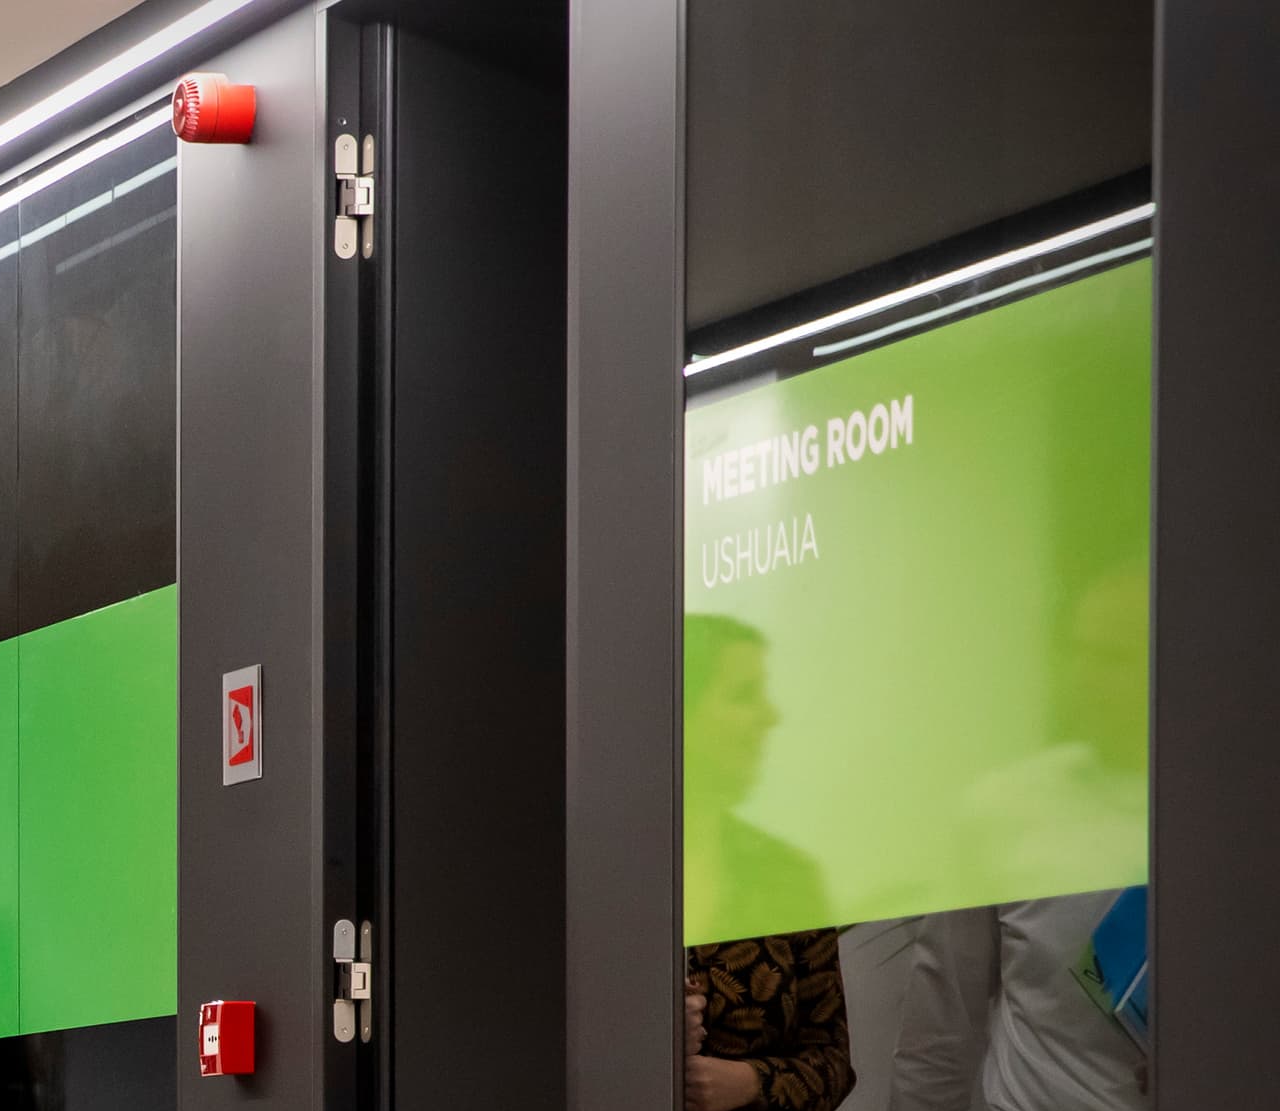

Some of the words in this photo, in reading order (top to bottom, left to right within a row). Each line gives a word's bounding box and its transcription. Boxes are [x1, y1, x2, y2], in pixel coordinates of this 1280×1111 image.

[702, 425, 820, 505] MEETING
[826, 394, 914, 469] ROOM
[701, 513, 820, 589] USHUAIA
